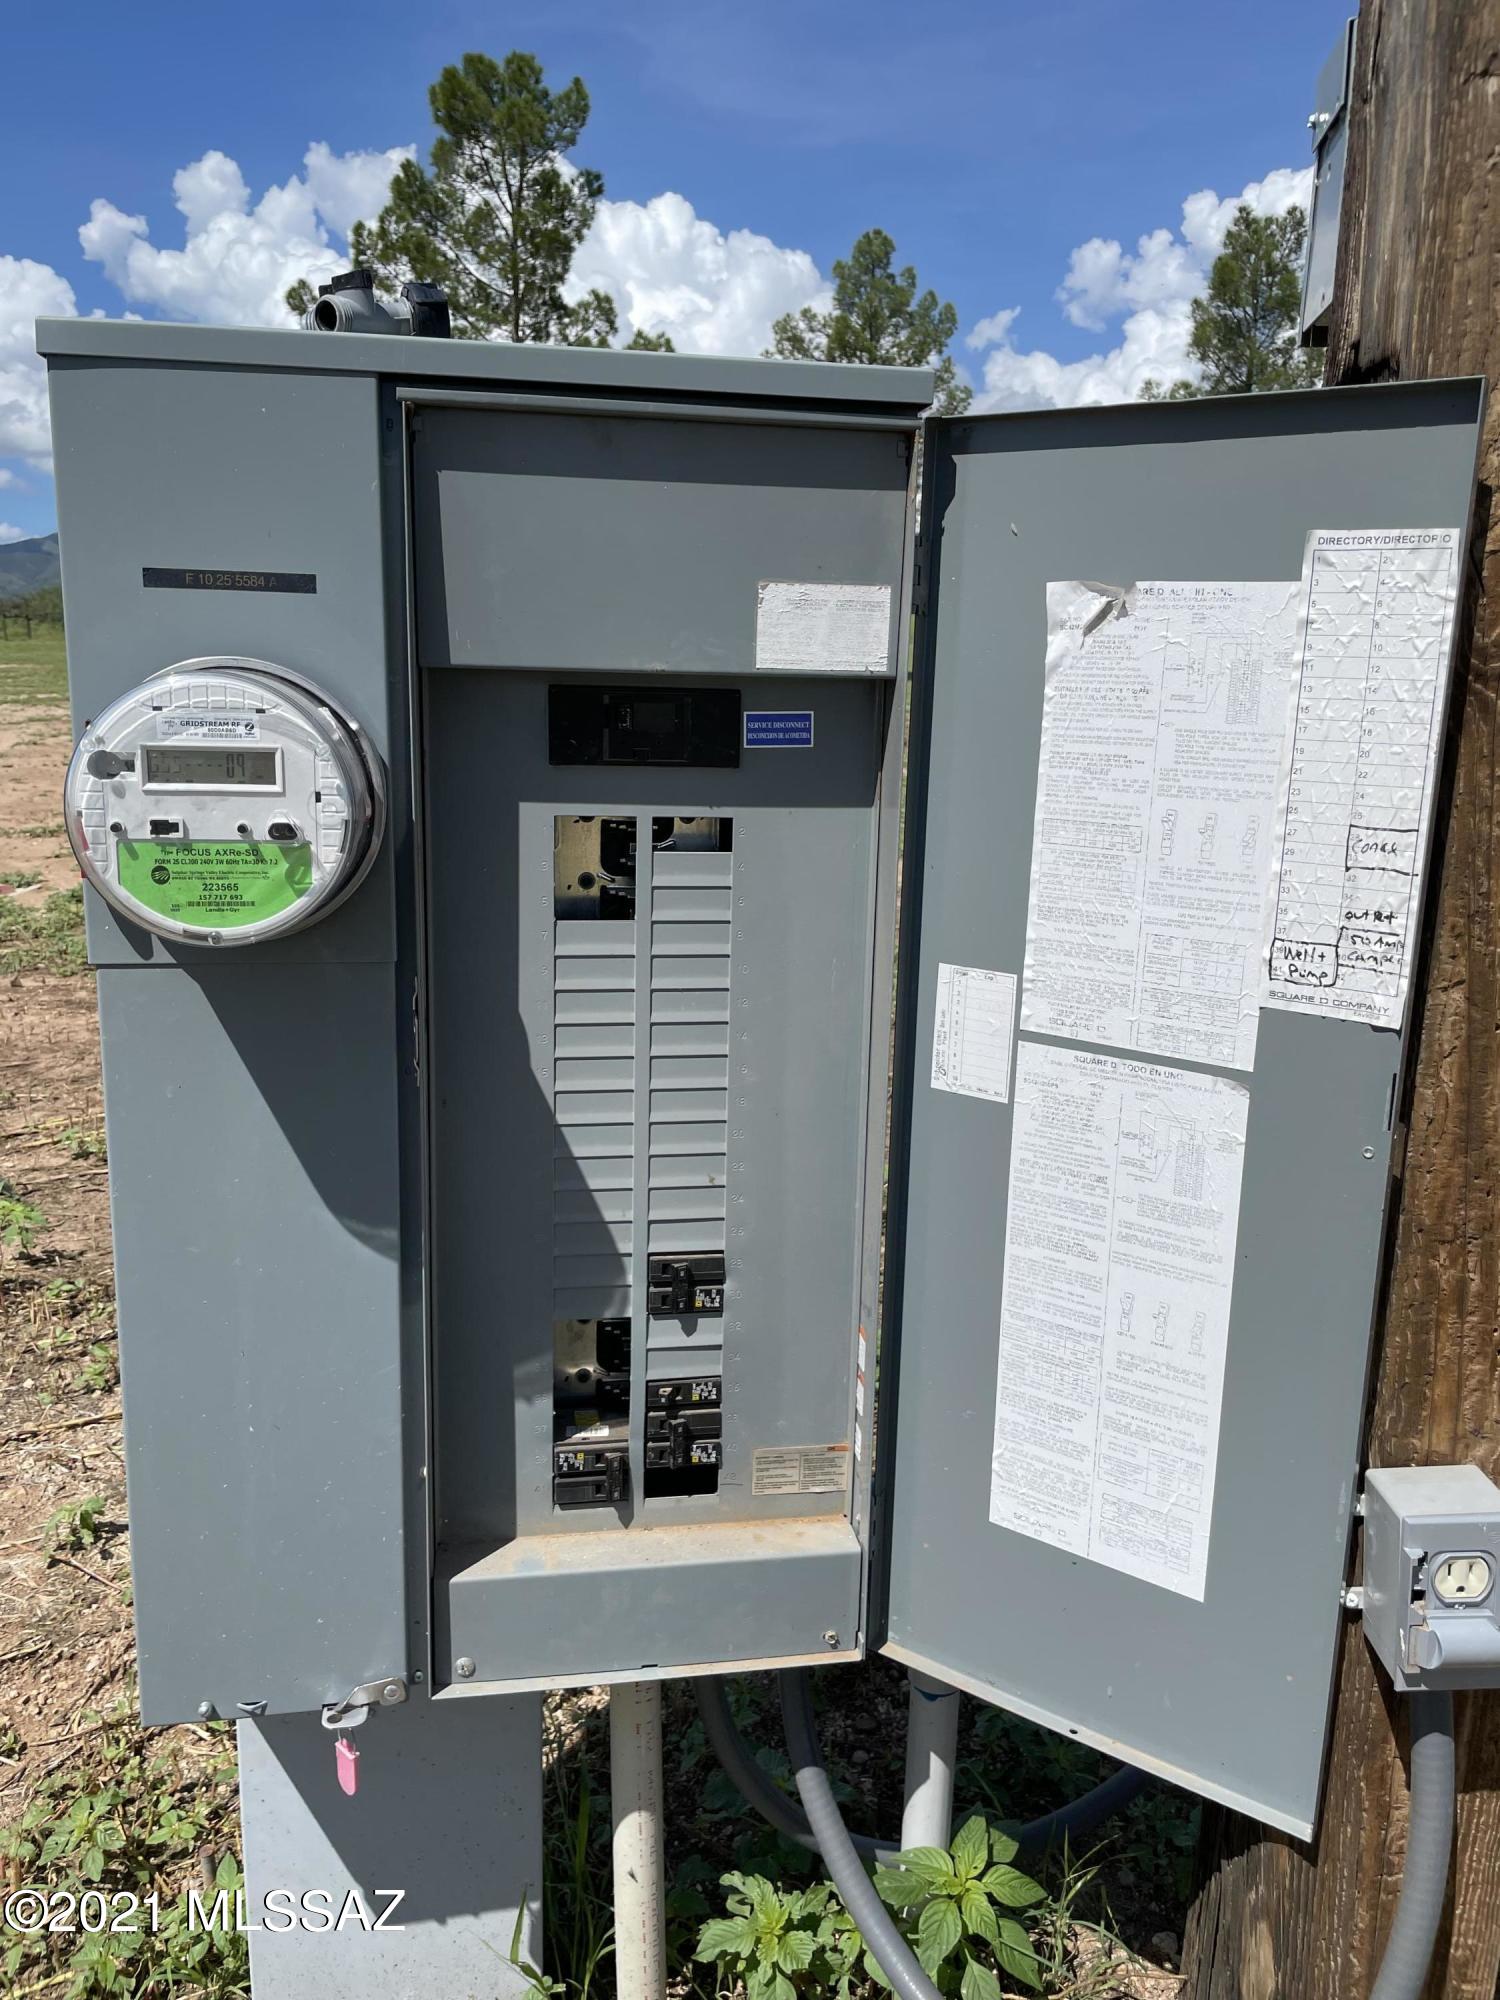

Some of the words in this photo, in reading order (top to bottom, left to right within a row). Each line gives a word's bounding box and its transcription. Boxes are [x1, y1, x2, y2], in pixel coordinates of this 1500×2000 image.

[199, 573, 213, 585] 10
[216, 574, 232, 586] 25
[235, 575, 265, 587] 5584
[773, 721, 809, 729] DISCONNECT
[202, 883, 239, 892] 223565
[1269, 990, 1315, 1003] SQUARE
[1333, 1000, 1390, 1015] COMPANY
[1074, 1055, 1109, 1068] SQUARE
